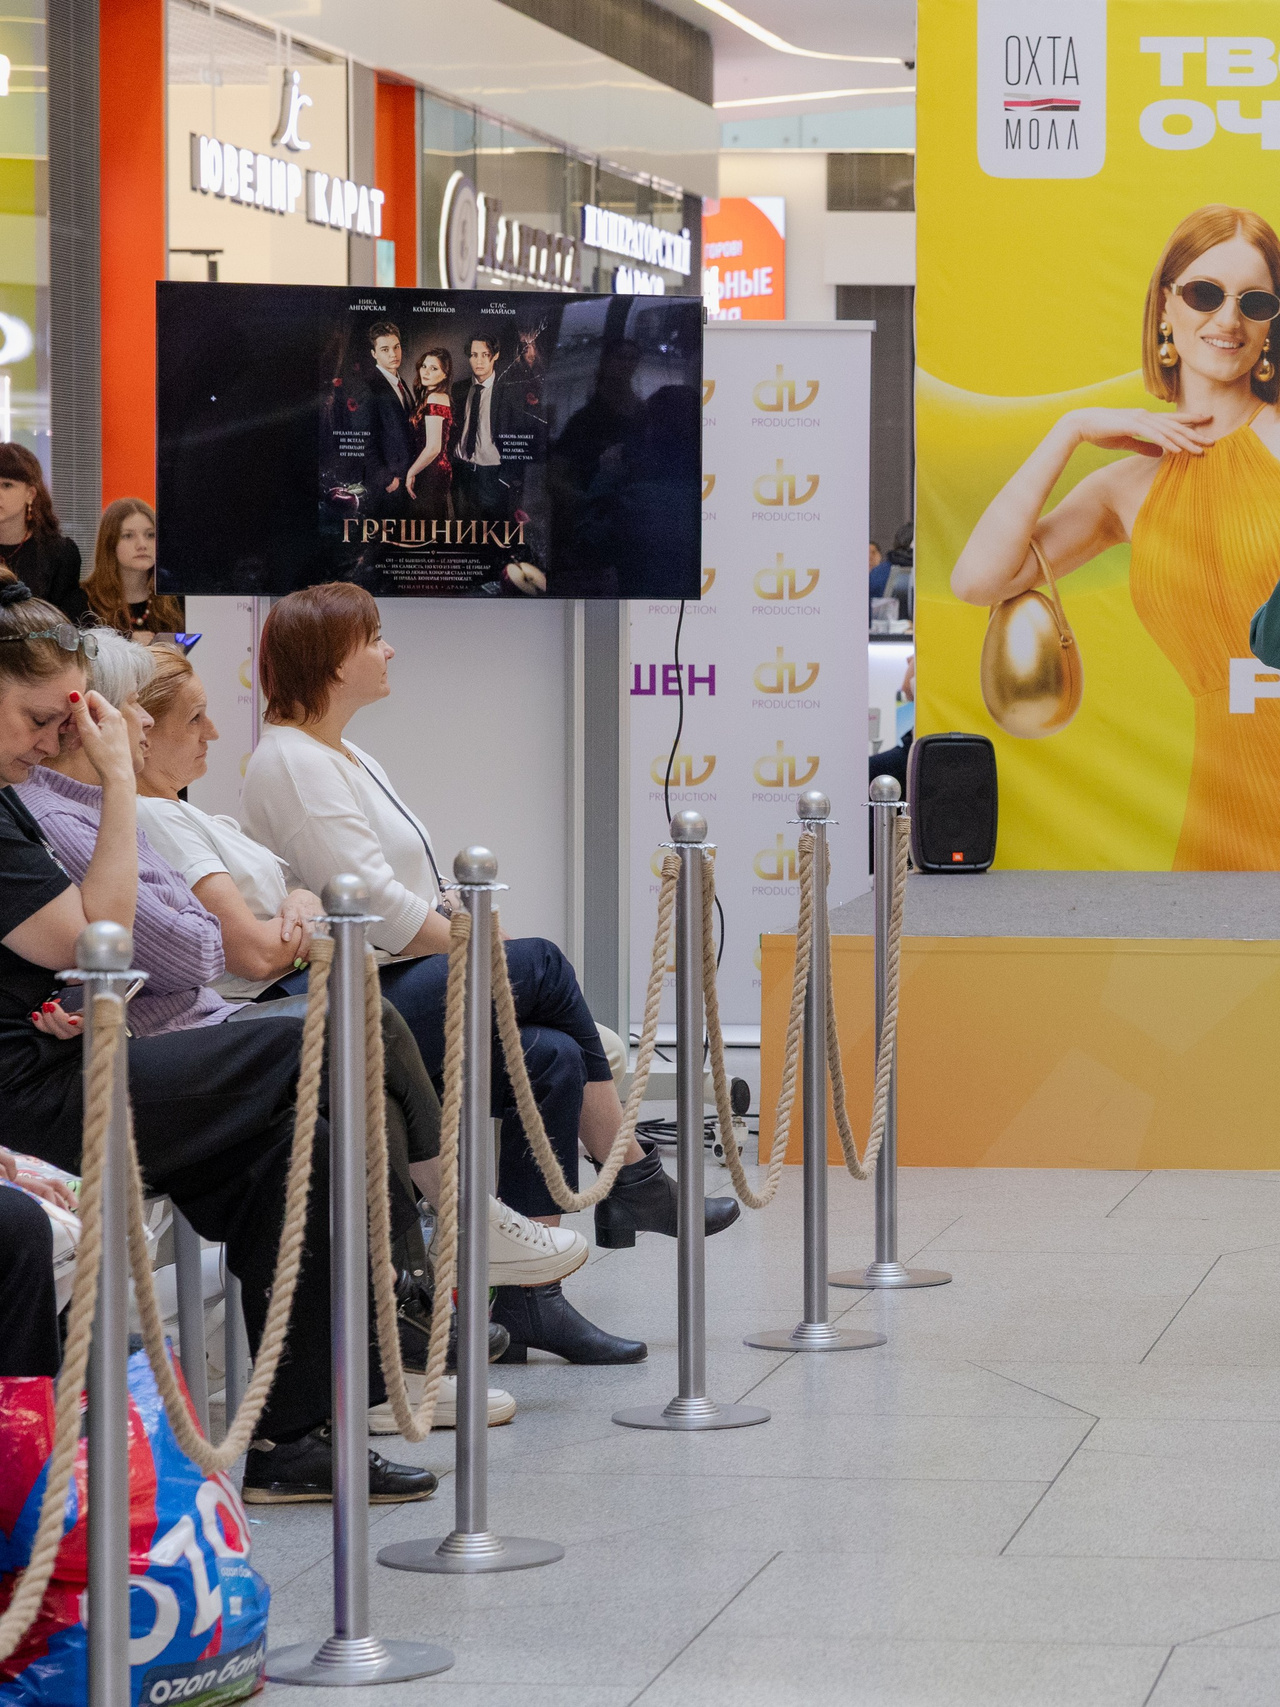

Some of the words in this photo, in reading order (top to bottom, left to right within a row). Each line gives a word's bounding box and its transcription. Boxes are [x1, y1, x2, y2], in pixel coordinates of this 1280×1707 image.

[1005, 34, 1080, 86] ОХТА
[1005, 118, 1079, 150] МОЛЛ
[199, 134, 303, 214] ЮВЕЛИР
[314, 170, 386, 238] КАРАТ
[348, 304, 387, 312] АНГОРСКАЯ
[412, 306, 456, 314] КОЛЕСНИКОВ
[752, 417, 821, 428] PRODUCTION
[752, 511, 821, 522] PRODUCTION
[341, 518, 526, 549] ГРЕШНИКИ
[752, 605, 821, 616] PRODUCTION
[752, 699, 821, 710] PRODUCTION
[752, 793, 801, 803] PRODUCT
[752, 886, 800, 896] PRODUCT
[149, 1668, 217, 1705] ozon
